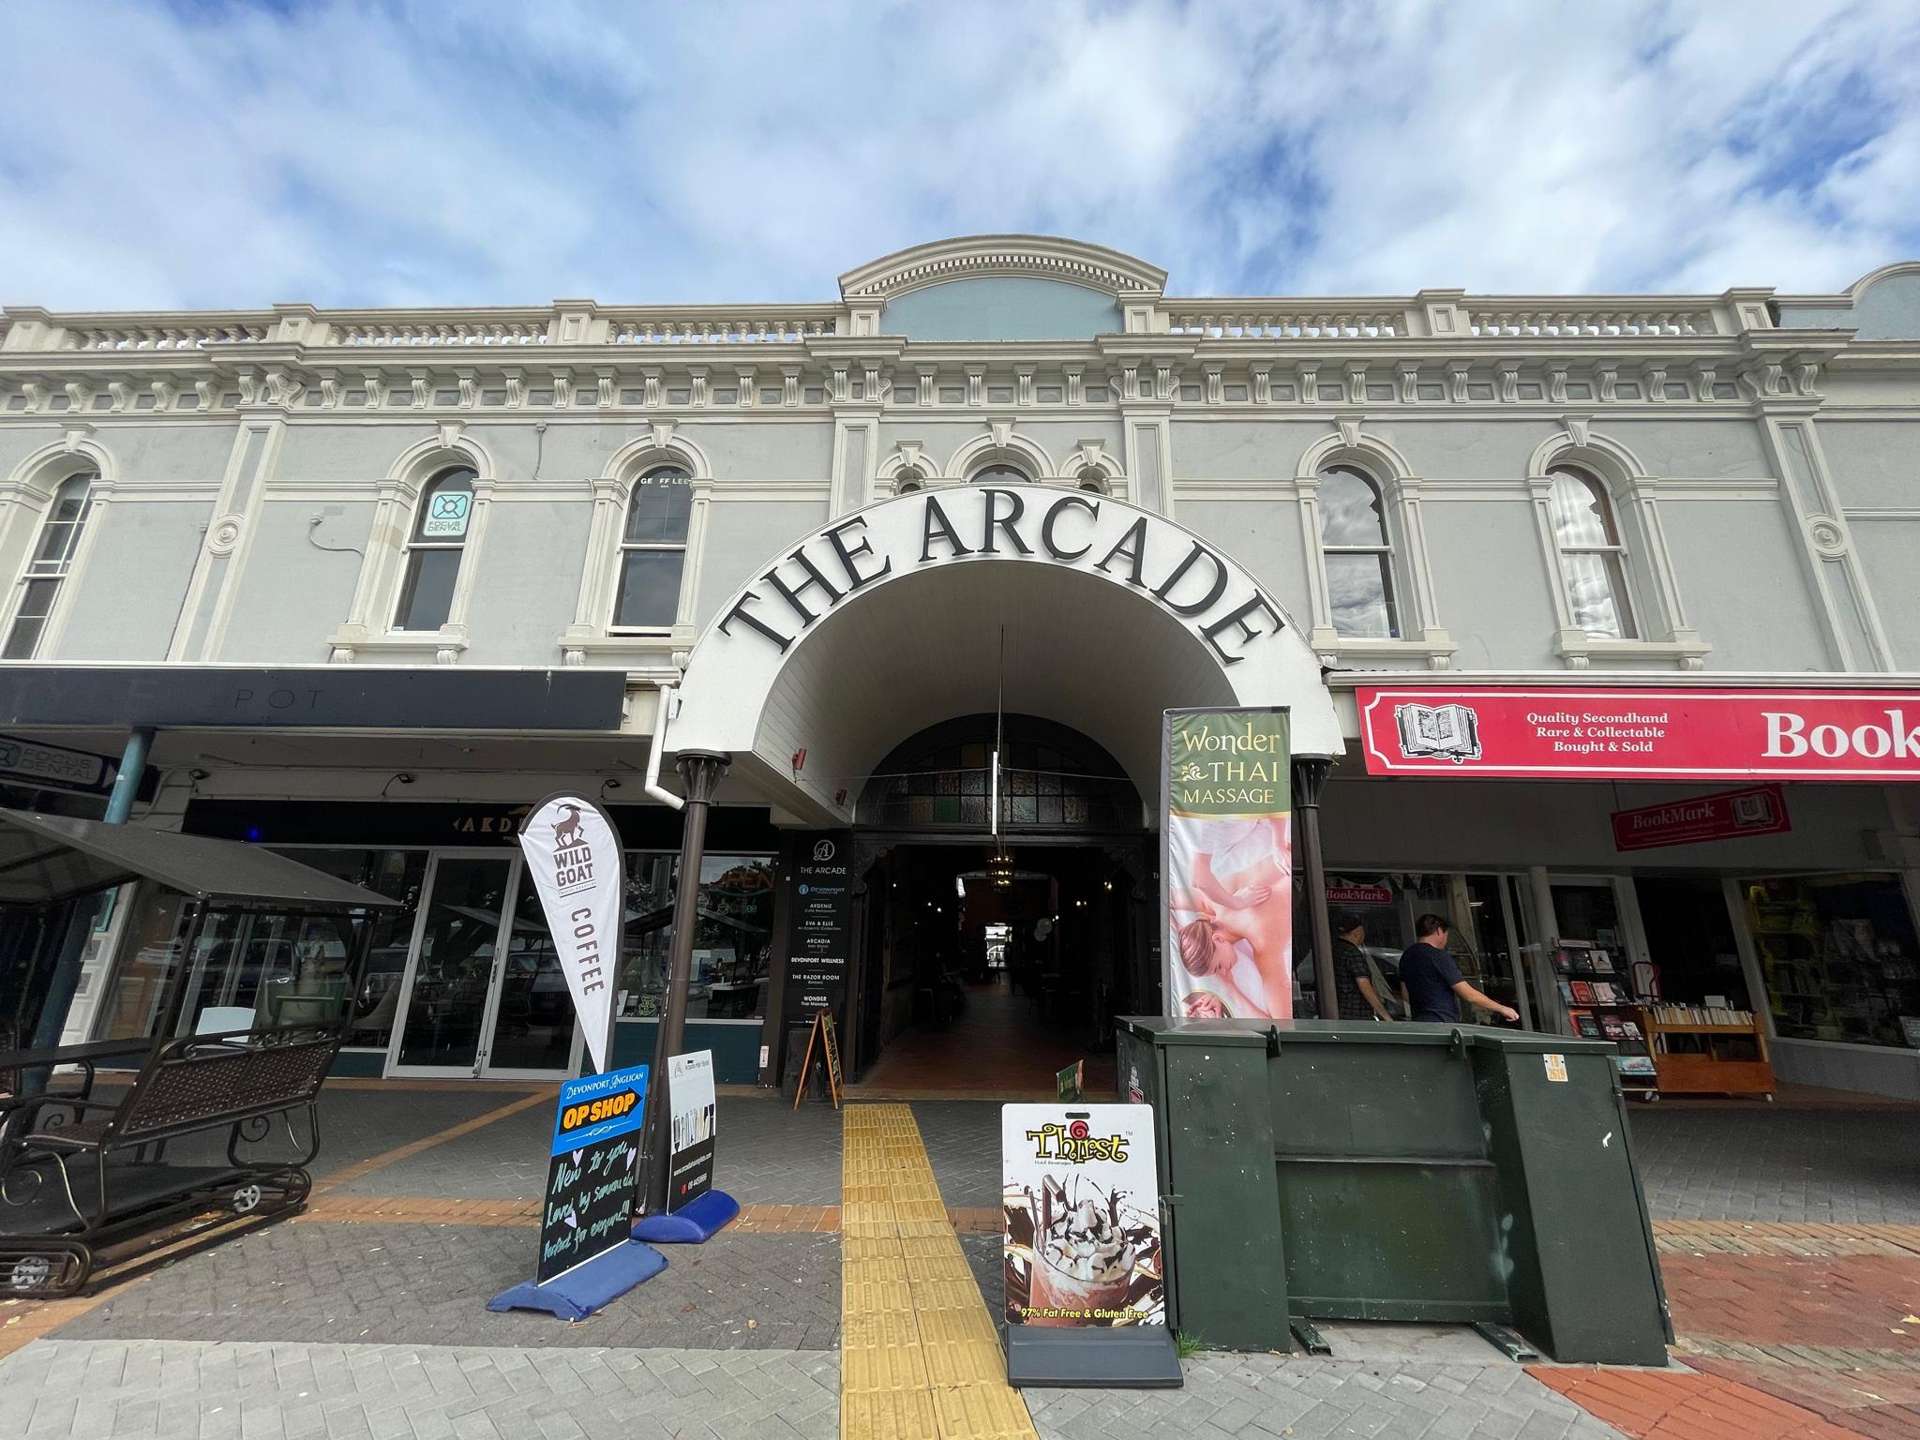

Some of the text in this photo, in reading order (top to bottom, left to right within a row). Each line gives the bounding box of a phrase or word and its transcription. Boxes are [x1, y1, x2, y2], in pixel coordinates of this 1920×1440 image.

[718, 489, 1285, 664] THE ARCADE
[1526, 712, 1668, 725] Quality Secondhand
[1182, 722, 1280, 755] Wonder
[1536, 727, 1665, 738] Rare & Collectable
[1554, 741, 1654, 754] Bought & Sold
[20, 759, 93, 780] DENTAL
[24, 748, 92, 770] FOCUS
[1208, 761, 1280, 782] THAI
[1184, 788, 1275, 804] MASSAGE
[1632, 803, 1716, 829] BookMark
[553, 847, 592, 869] WILD
[556, 863, 593, 887] GOAT
[800, 866, 847, 875] THE ARCADE
[571, 907, 605, 996] COFFEE
[566, 1072, 644, 1099] DEVONPORT ANGLICAN
[563, 1093, 636, 1130] OP SHOP
[1026, 1120, 1130, 1164] Thirst
[551, 1140, 629, 1195] New to you
[1021, 1308, 1149, 1320] 97% Fat Free & Gluten Free
